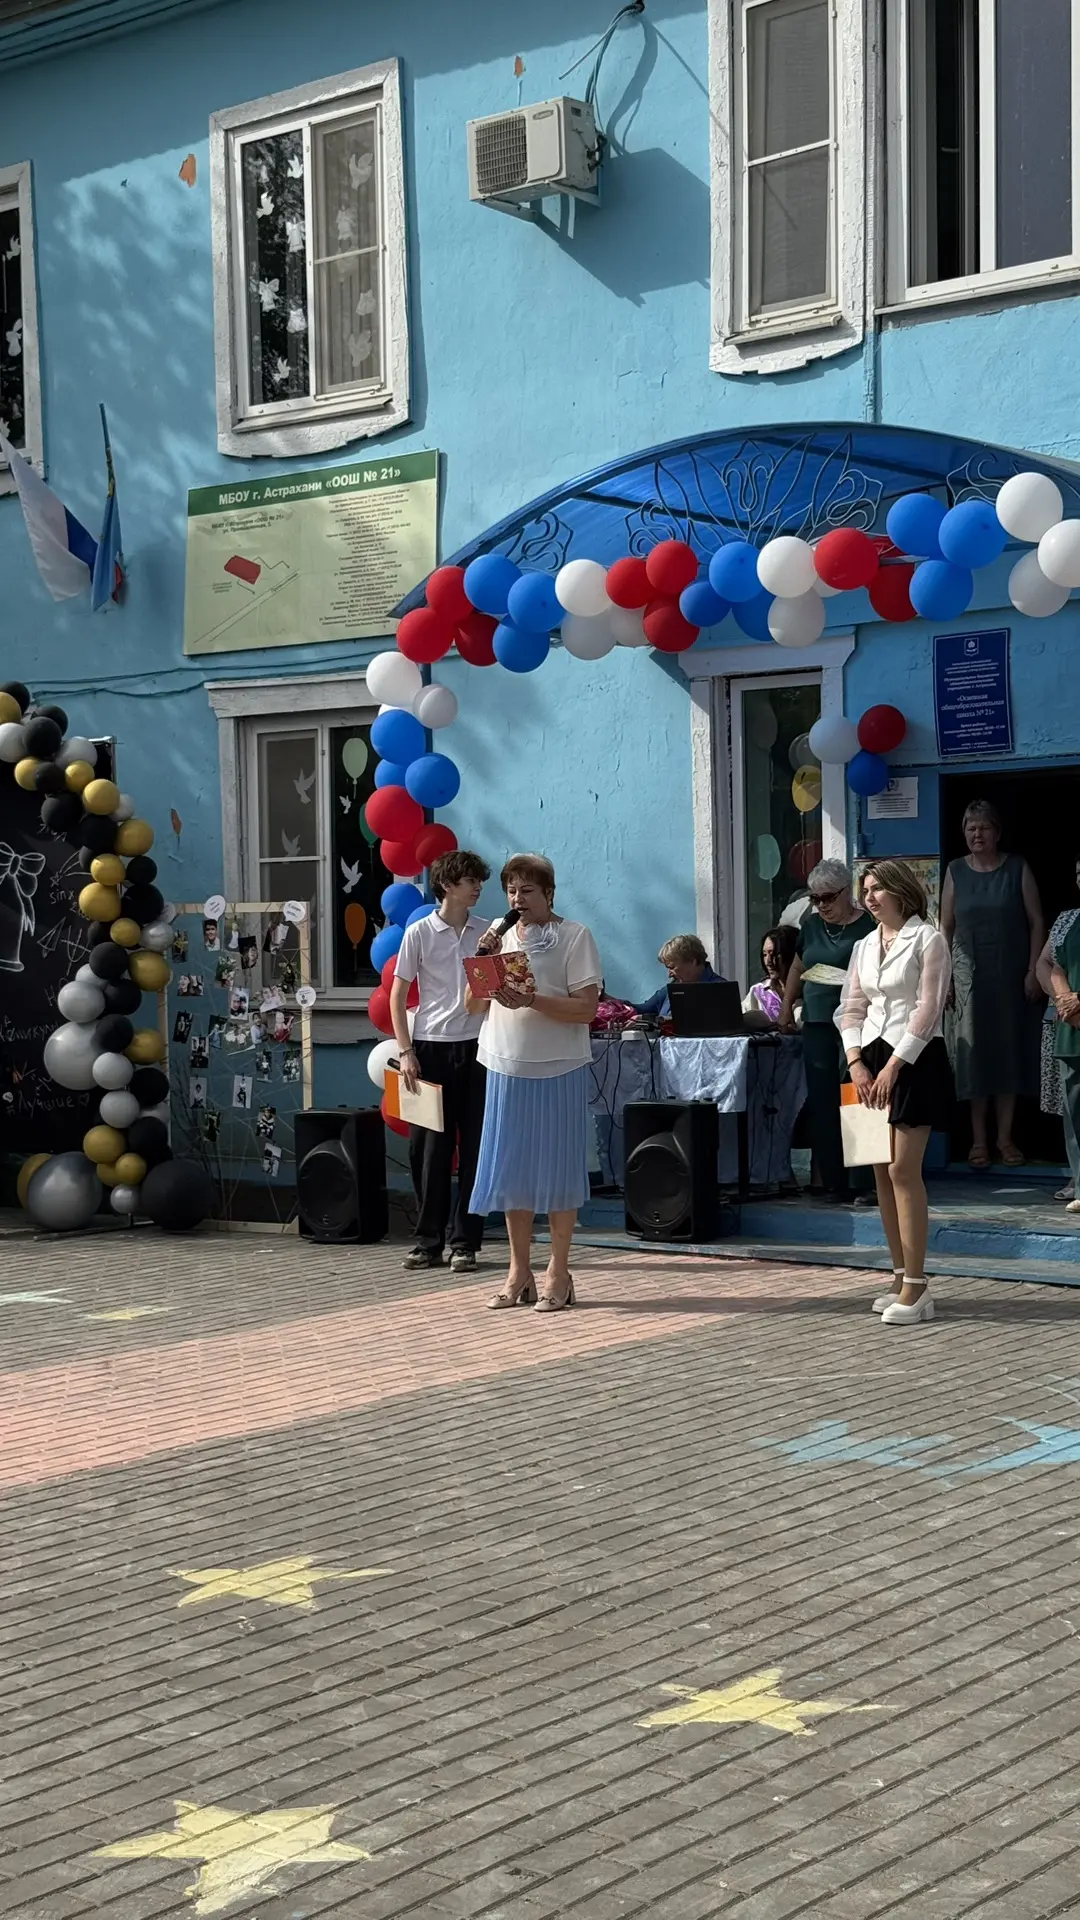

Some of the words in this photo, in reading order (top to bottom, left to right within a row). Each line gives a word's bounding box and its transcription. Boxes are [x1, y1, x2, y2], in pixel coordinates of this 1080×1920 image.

[219, 489, 250, 506] МБОУ
[252, 490, 261, 500] г.
[264, 482, 323, 499] Астрахани
[326, 473, 360, 490] «ООШ
[363, 469, 377, 484] №
[381, 466, 402, 481] 21»
